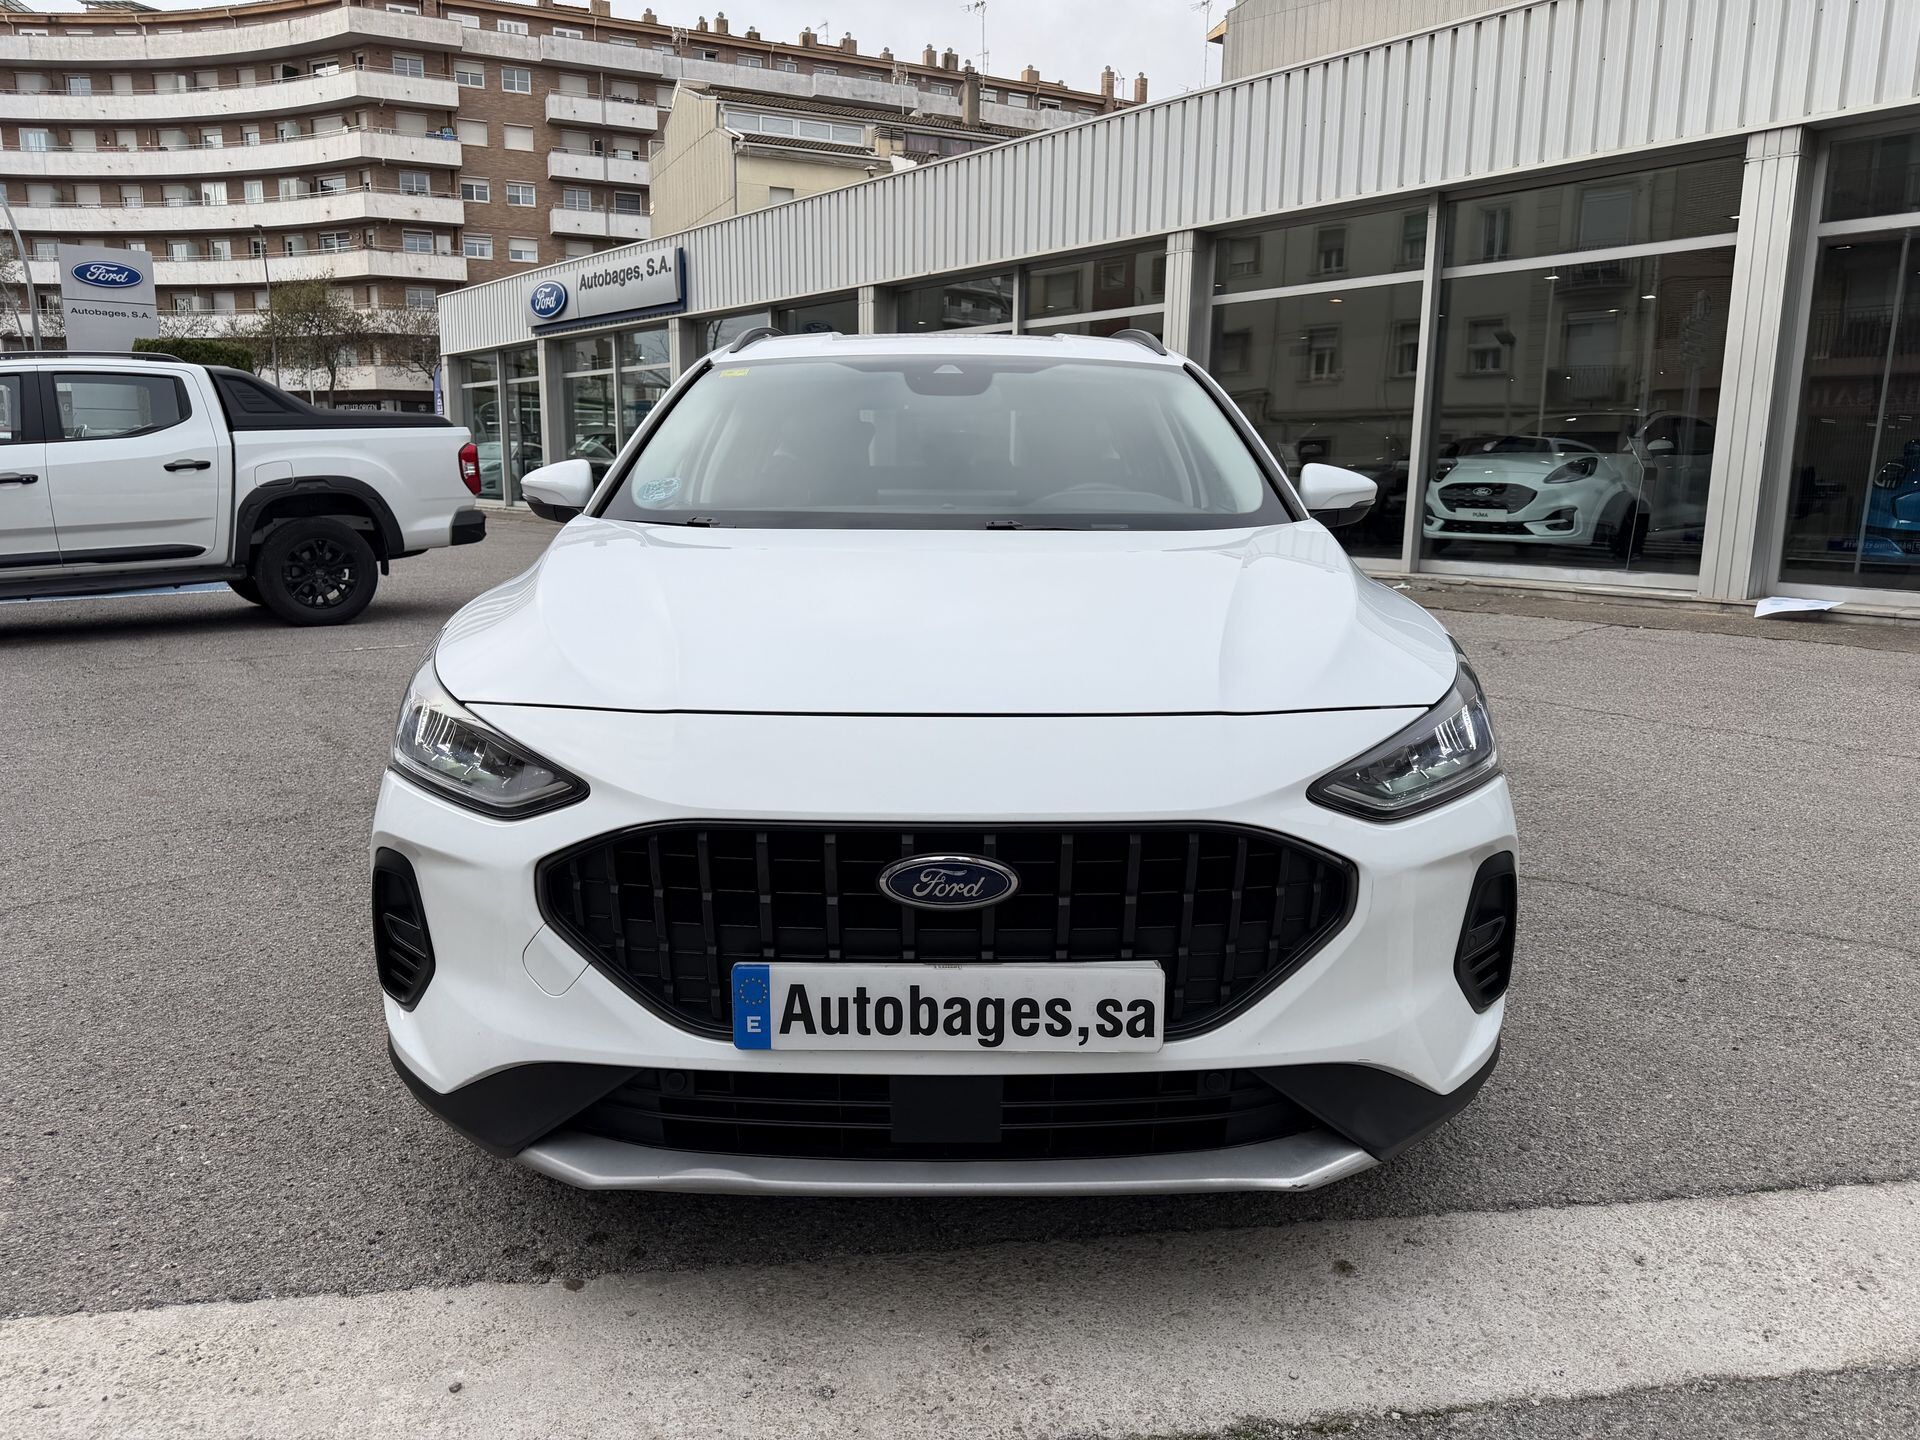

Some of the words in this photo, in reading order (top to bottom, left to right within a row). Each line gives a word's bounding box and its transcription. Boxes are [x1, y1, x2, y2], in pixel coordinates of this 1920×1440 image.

[86, 264, 128, 282] Ford
[579, 265, 644, 291] Autobages,
[646, 255, 672, 277] S.A.
[535, 287, 557, 310] Ford
[70, 307, 130, 318] Autobages,
[131, 311, 152, 319] S.A.
[912, 868, 985, 898] Ford
[746, 1016, 762, 1033] E
[779, 984, 1156, 1047] Autobages,sa
